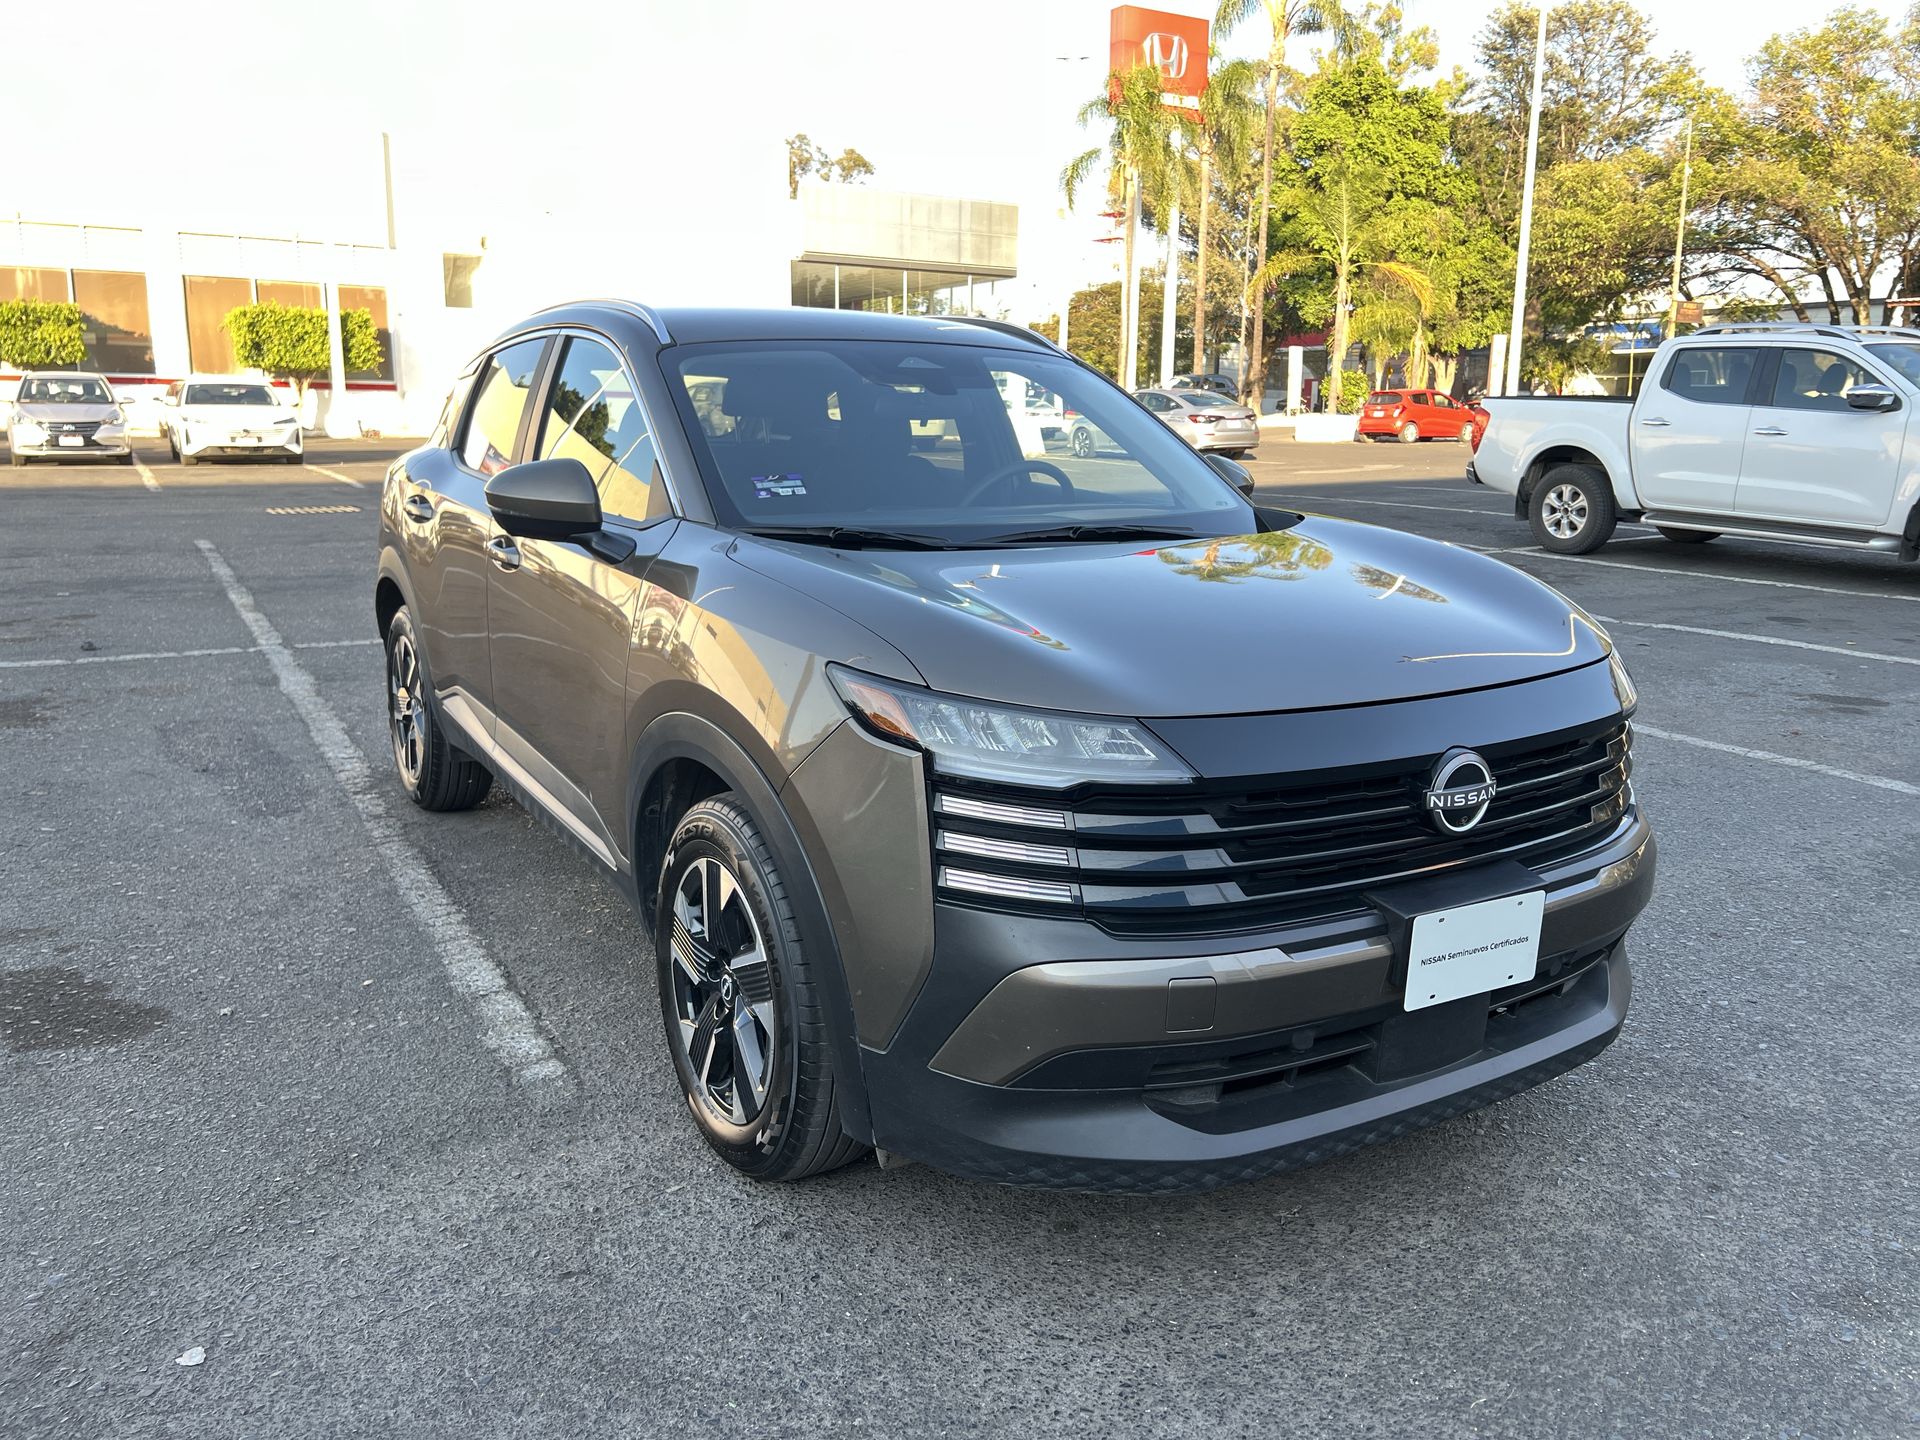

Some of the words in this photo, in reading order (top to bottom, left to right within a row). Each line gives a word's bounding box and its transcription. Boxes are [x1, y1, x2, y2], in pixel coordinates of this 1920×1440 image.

[1430, 784, 1497, 808] NISSAN
[1420, 953, 1447, 967] NISSAN
[1447, 945, 1489, 961] Seminuevos
[1489, 935, 1529, 951] Certificados
